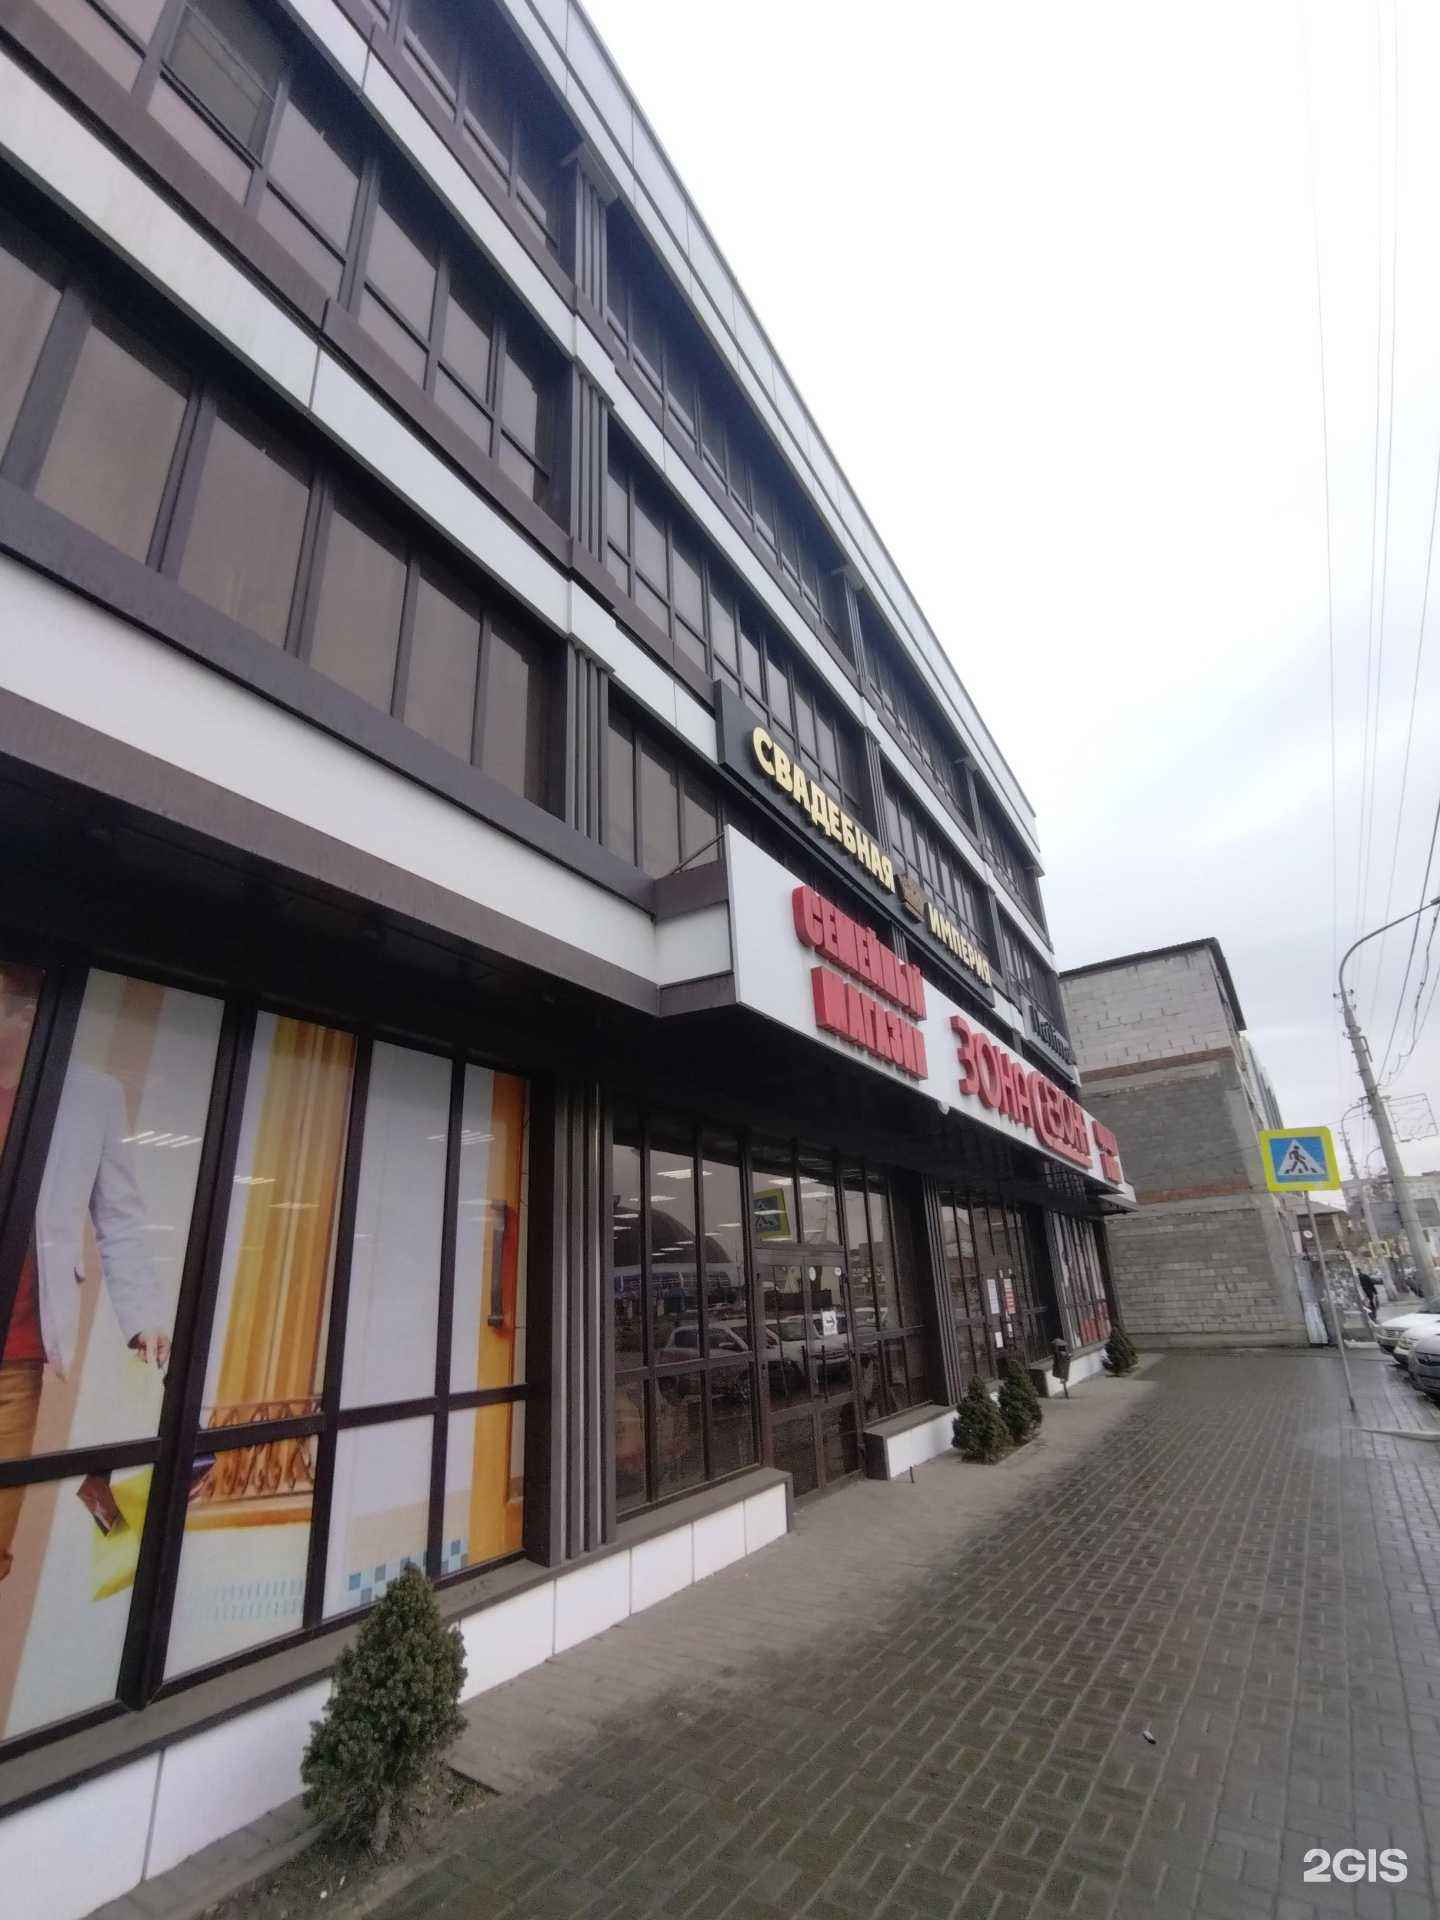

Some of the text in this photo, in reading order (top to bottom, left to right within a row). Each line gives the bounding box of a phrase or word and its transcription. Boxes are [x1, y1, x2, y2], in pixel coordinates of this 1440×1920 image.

[753, 727, 992, 988] СВАДЕБНАЯ ИМПЕРИЯ
[811, 966, 928, 1080] МАГАЗИН
